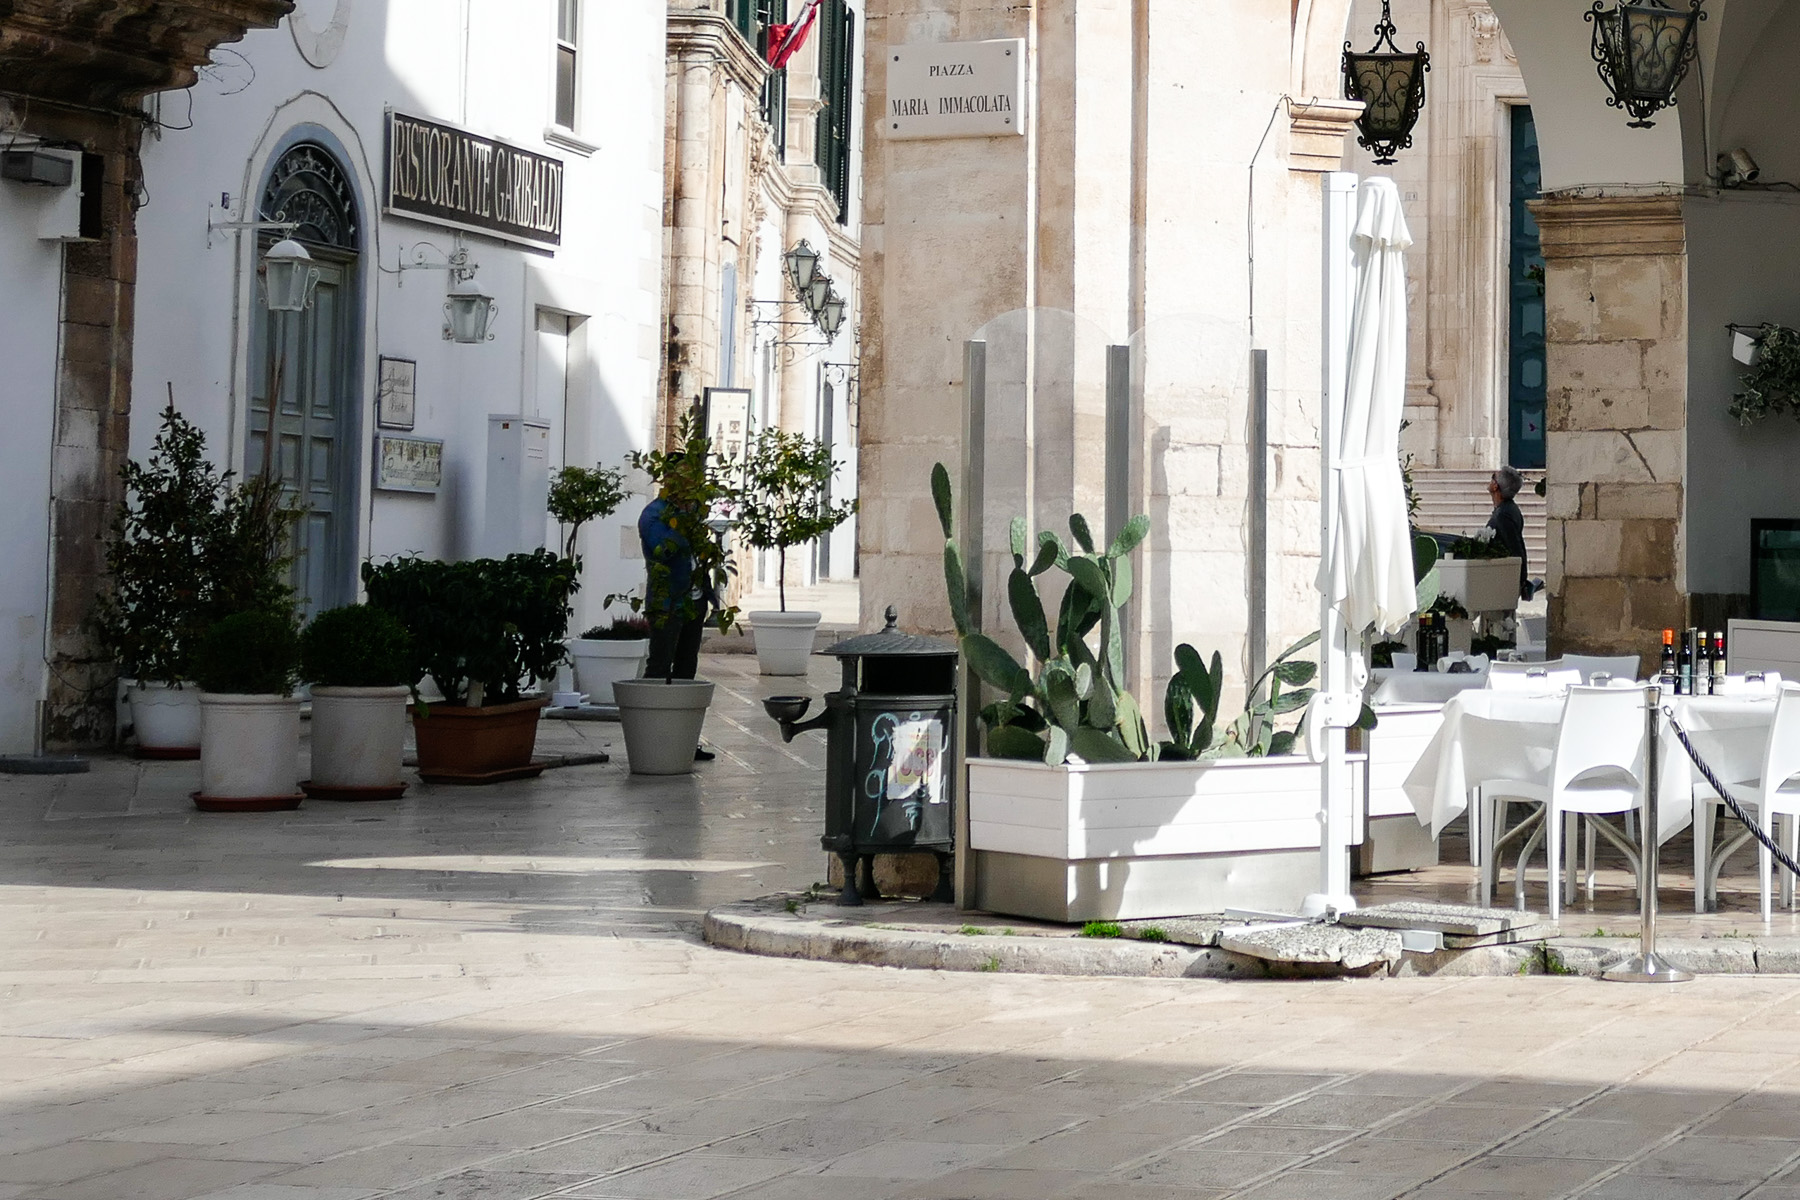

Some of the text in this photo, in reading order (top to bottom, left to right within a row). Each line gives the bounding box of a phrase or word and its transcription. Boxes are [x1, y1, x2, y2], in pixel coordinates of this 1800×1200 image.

[929, 64, 974, 77] PIAZZA
[892, 94, 1011, 117] MARIA IMMACOLATA
[393, 119, 562, 235] RISTORANTE GARIBALDI
